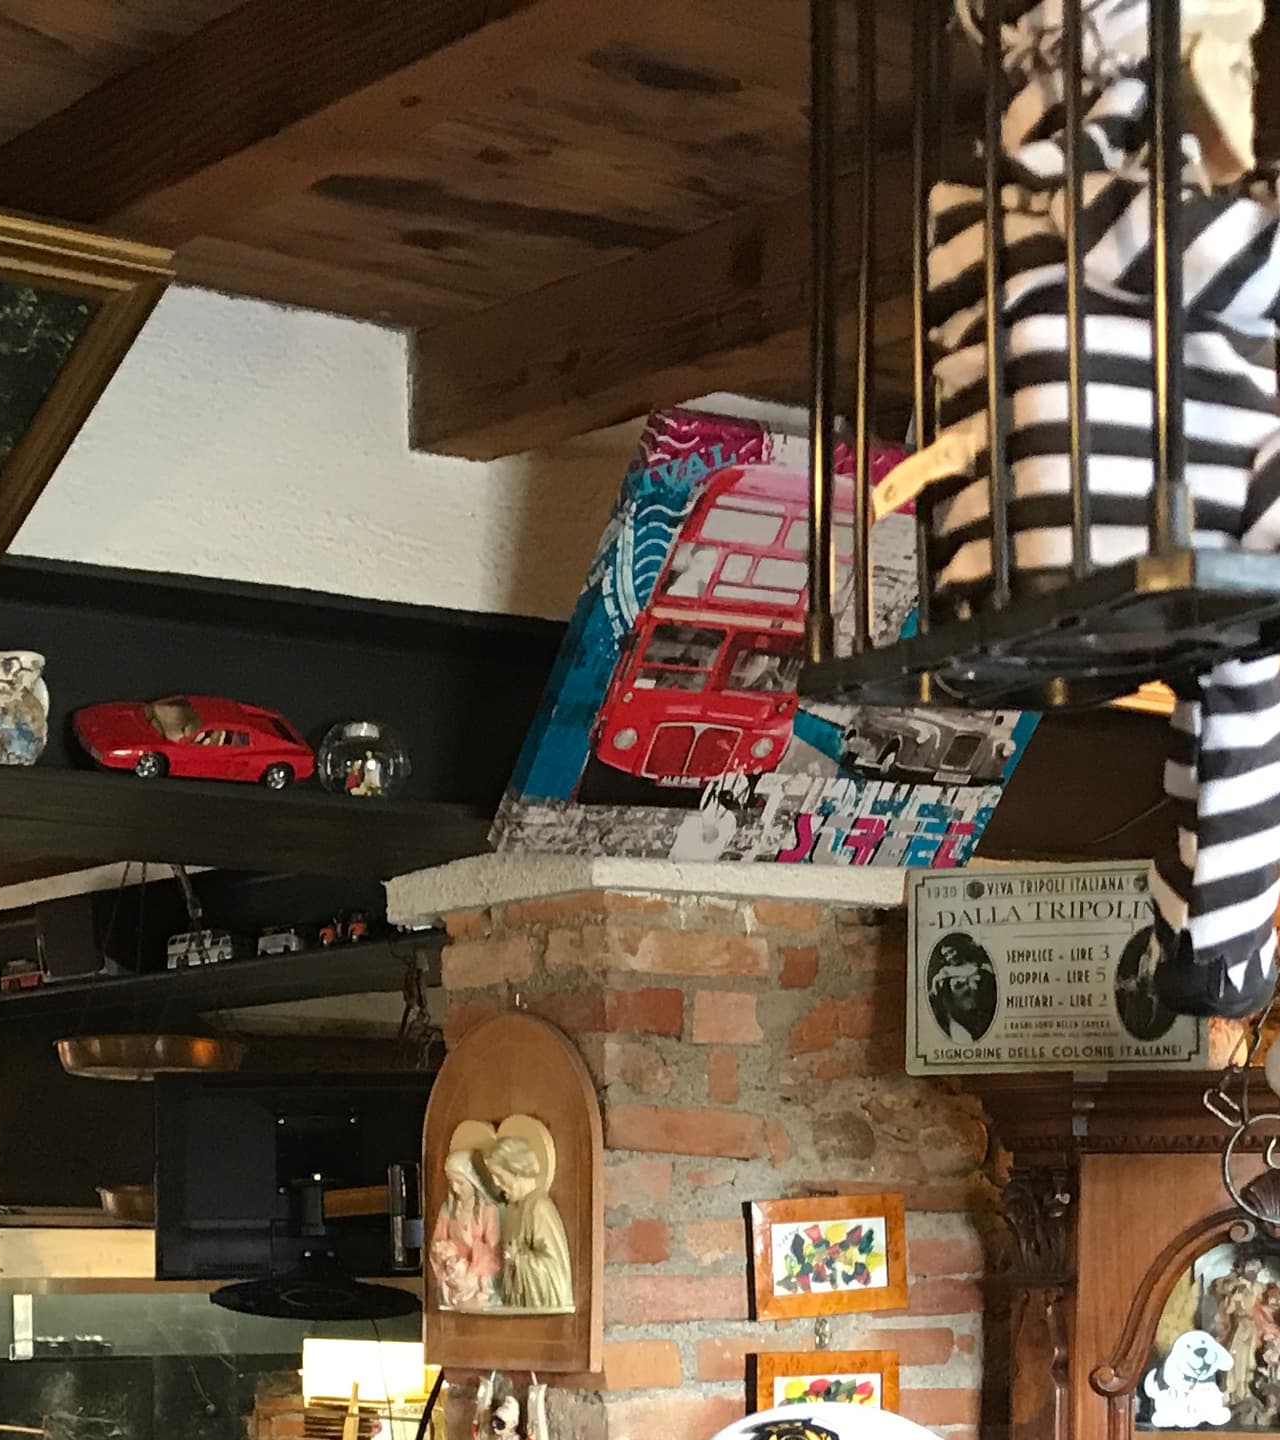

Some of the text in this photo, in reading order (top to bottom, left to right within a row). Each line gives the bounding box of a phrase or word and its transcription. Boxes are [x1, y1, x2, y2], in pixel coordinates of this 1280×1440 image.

[927, 885, 958, 899] 1930
[986, 881, 1014, 896] VIVA
[1020, 878, 1065, 894] TRIPOLI
[1028, 900, 1155, 921] TRIPOLIN
[1006, 948, 1054, 963] SEMPLICE
[1070, 946, 1094, 961] LIRE
[1099, 944, 1110, 961] 3
[1009, 971, 1050, 985] DOPPIA
[1067, 969, 1090, 984] LIRE
[1095, 966, 1106, 984] 5
[1006, 994, 1054, 1009] MILITARI
[1070, 992, 1093, 1007] LIRE
[933, 1047, 1002, 1061] SIGNORINE
[1008, 1046, 1046, 1060] DELLE
[1052, 1045, 1114, 1059] COLONIE
